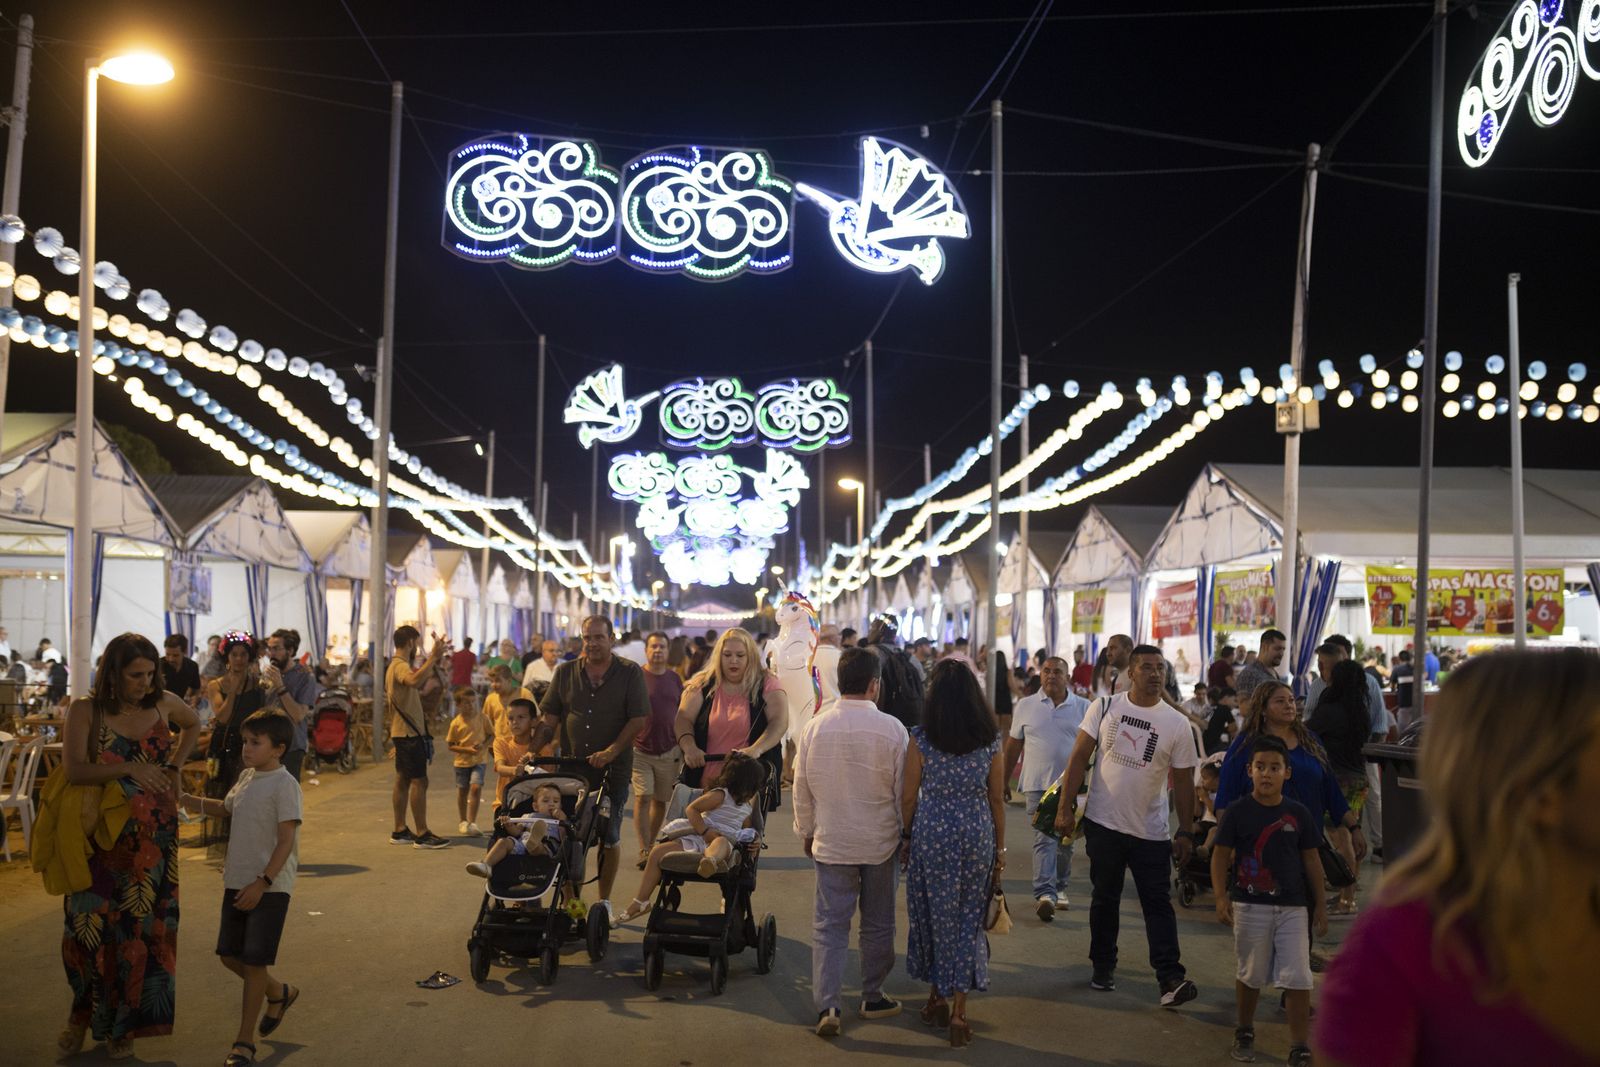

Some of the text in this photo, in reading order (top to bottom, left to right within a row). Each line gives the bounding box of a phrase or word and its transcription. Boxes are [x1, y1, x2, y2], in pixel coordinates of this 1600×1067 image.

[1411, 571, 1560, 592] CPAS MACEON
[1120, 714, 1151, 731] PUMA
[1142, 732, 1159, 763] PUMA
